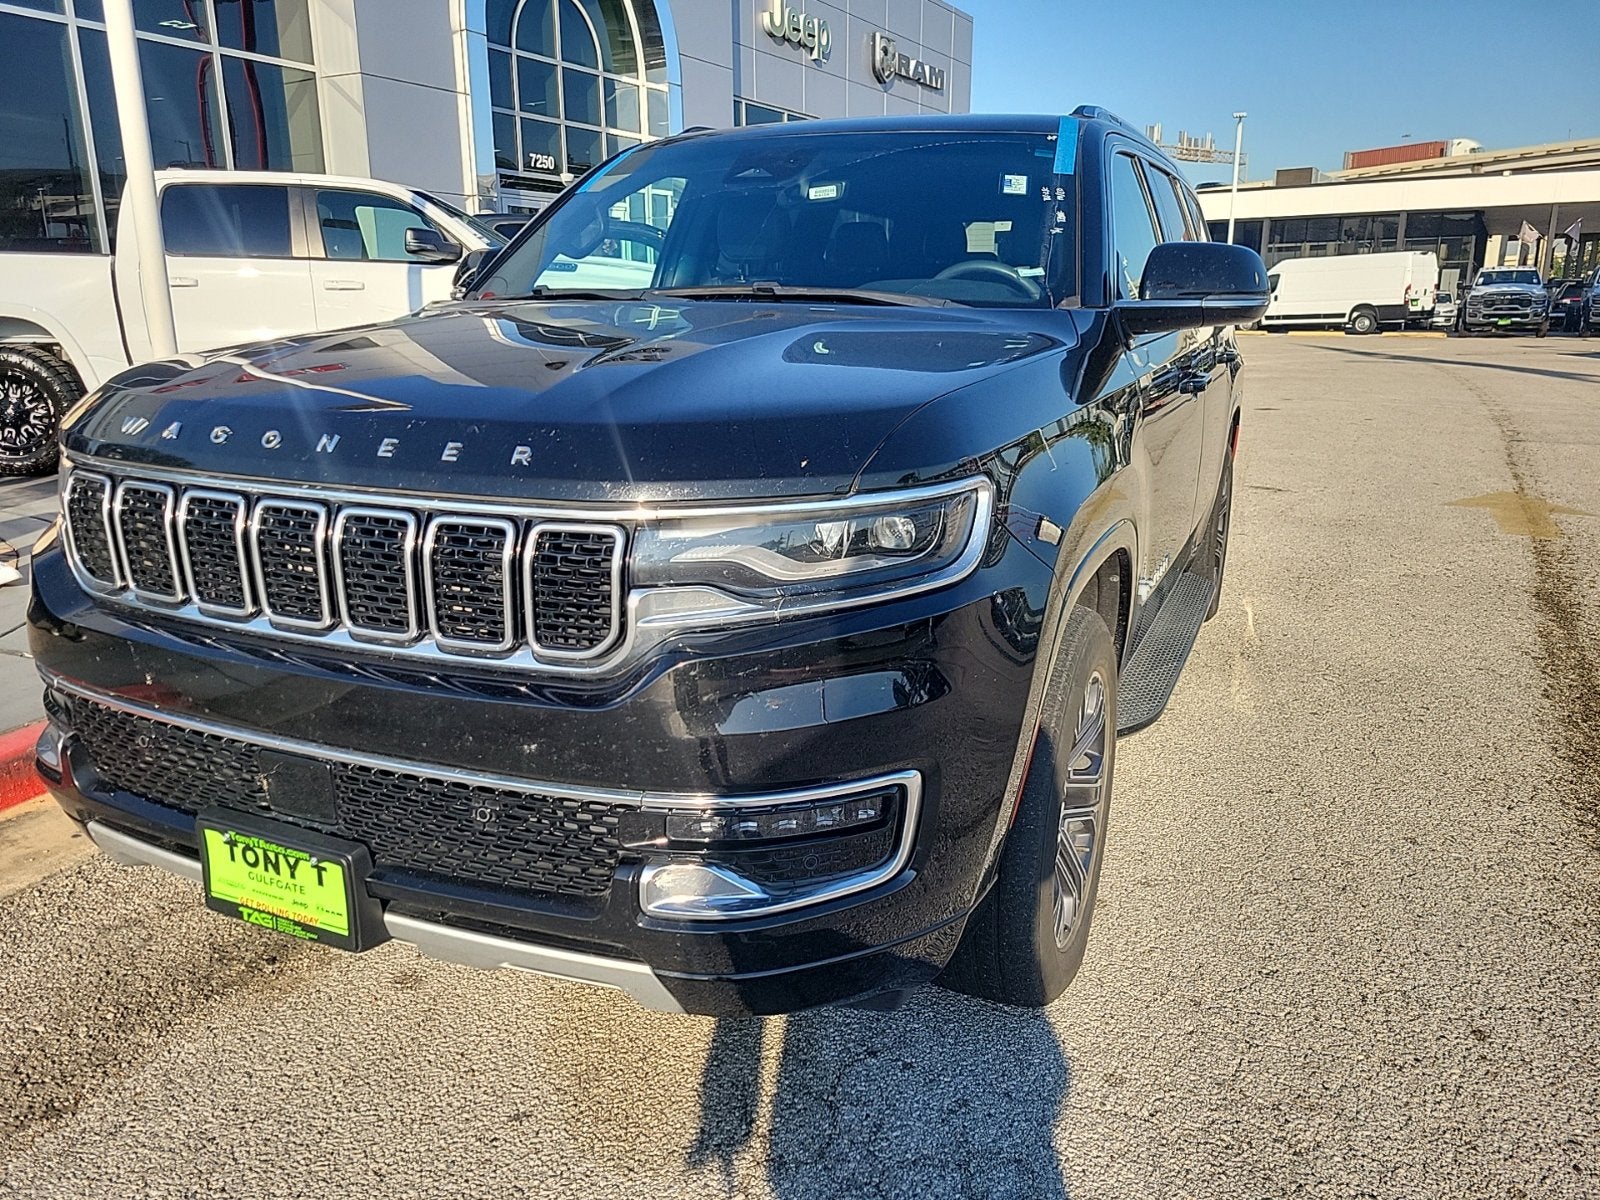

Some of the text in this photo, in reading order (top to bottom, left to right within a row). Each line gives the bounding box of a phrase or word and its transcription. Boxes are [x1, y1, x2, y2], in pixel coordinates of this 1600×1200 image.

[763, 0, 832, 63] Jeep
[896, 53, 946, 90] RAM
[529, 152, 555, 170] 7250
[121, 416, 533, 467] WAGONEER
[224, 841, 328, 888] TONY T
[248, 871, 306, 895] GULFGATE
[239, 896, 254, 908] GET
[256, 901, 290, 917] ROLLING
[292, 911, 320, 925] TODAY
